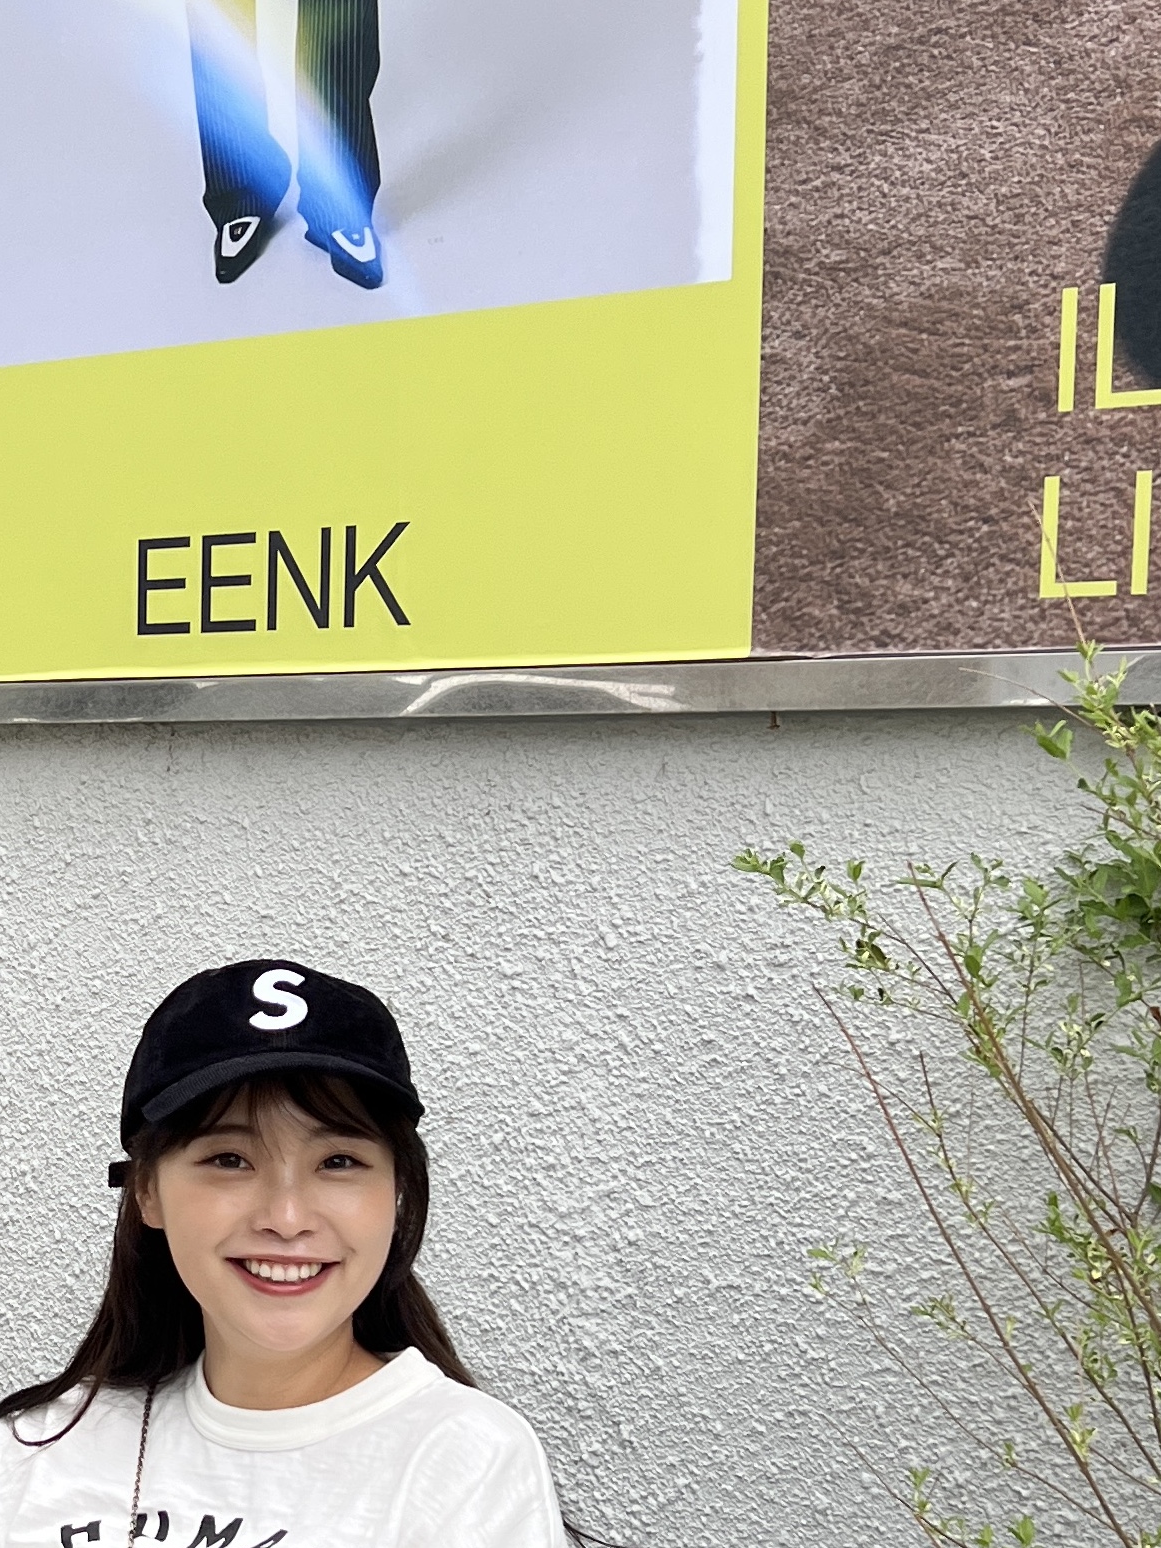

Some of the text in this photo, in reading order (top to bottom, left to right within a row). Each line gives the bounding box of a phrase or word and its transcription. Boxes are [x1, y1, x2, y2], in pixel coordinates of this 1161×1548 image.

[1058, 283, 1161, 412] IL
[137, 521, 411, 635] EENK
[248, 968, 309, 1030] S
